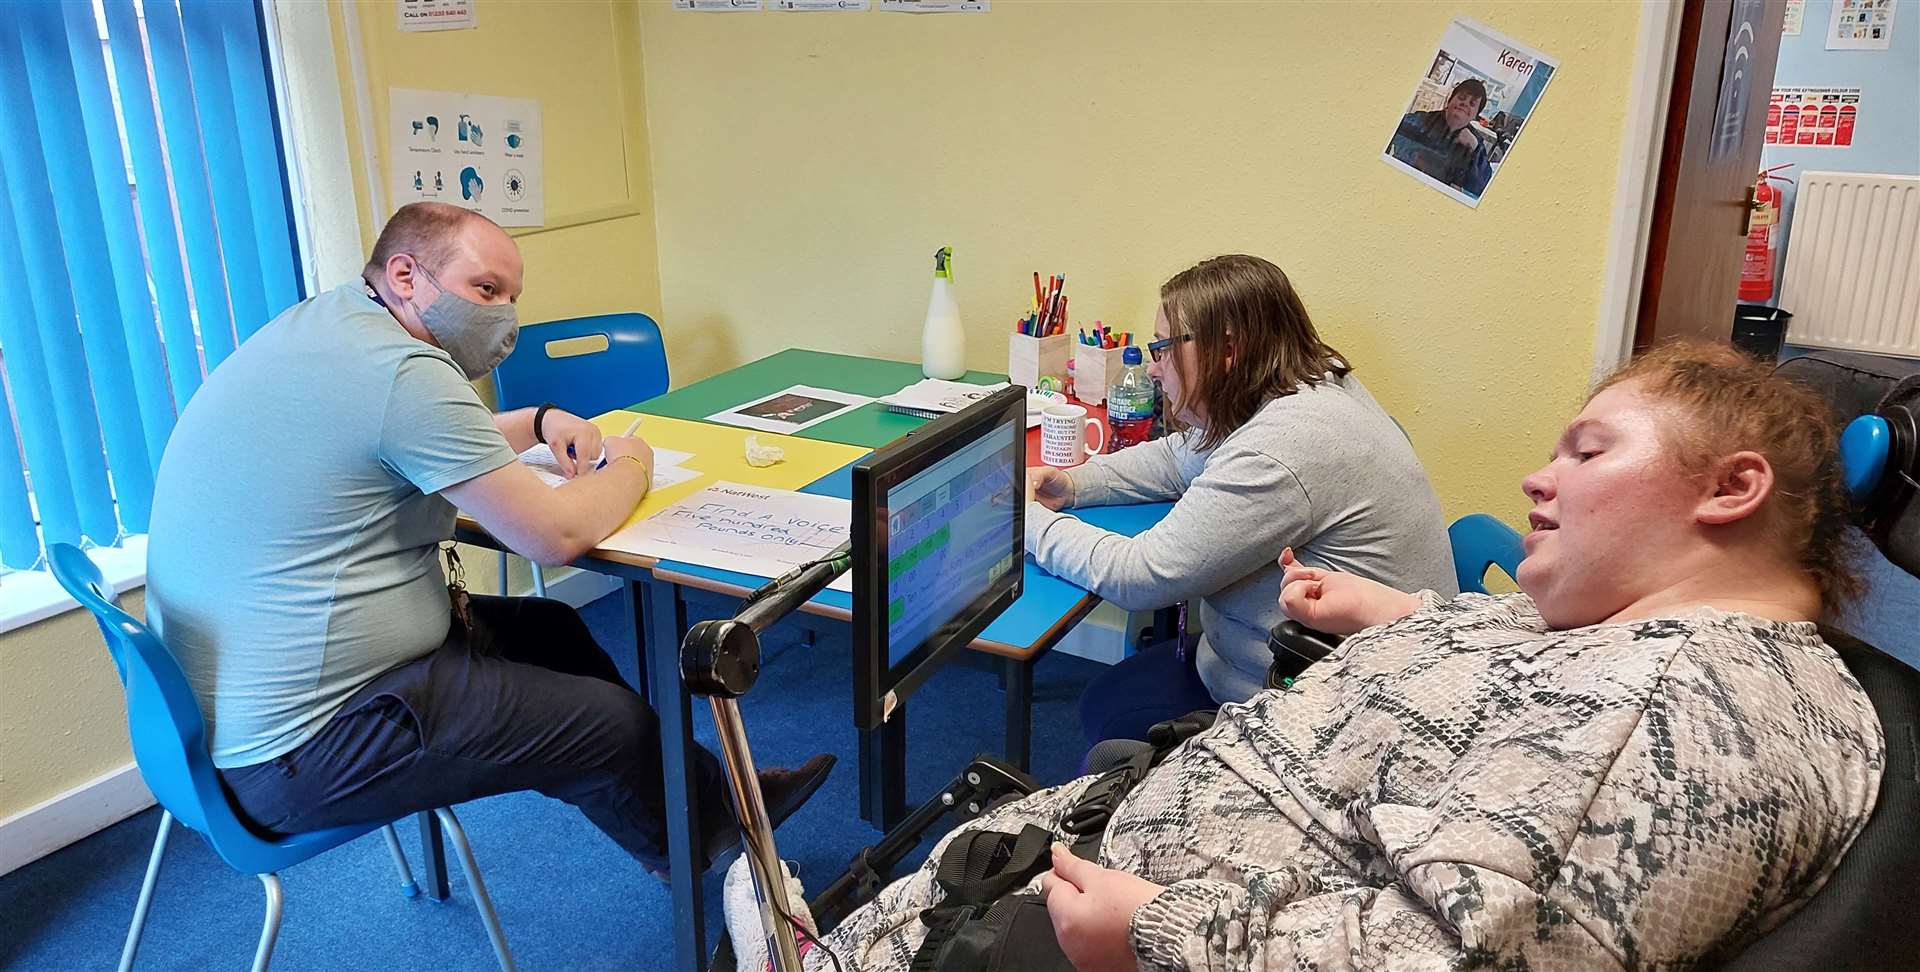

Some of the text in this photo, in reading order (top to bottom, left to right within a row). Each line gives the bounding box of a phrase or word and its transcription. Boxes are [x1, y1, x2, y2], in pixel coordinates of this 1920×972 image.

[1497, 49, 1534, 76] Karen
[1043, 432, 1077, 441] EXHAUSTED
[1045, 450, 1072, 458] AWESOME
[1043, 455, 1075, 464] YESTERDAY
[720, 489, 771, 500] NatWest
[672, 510, 712, 520] Five
